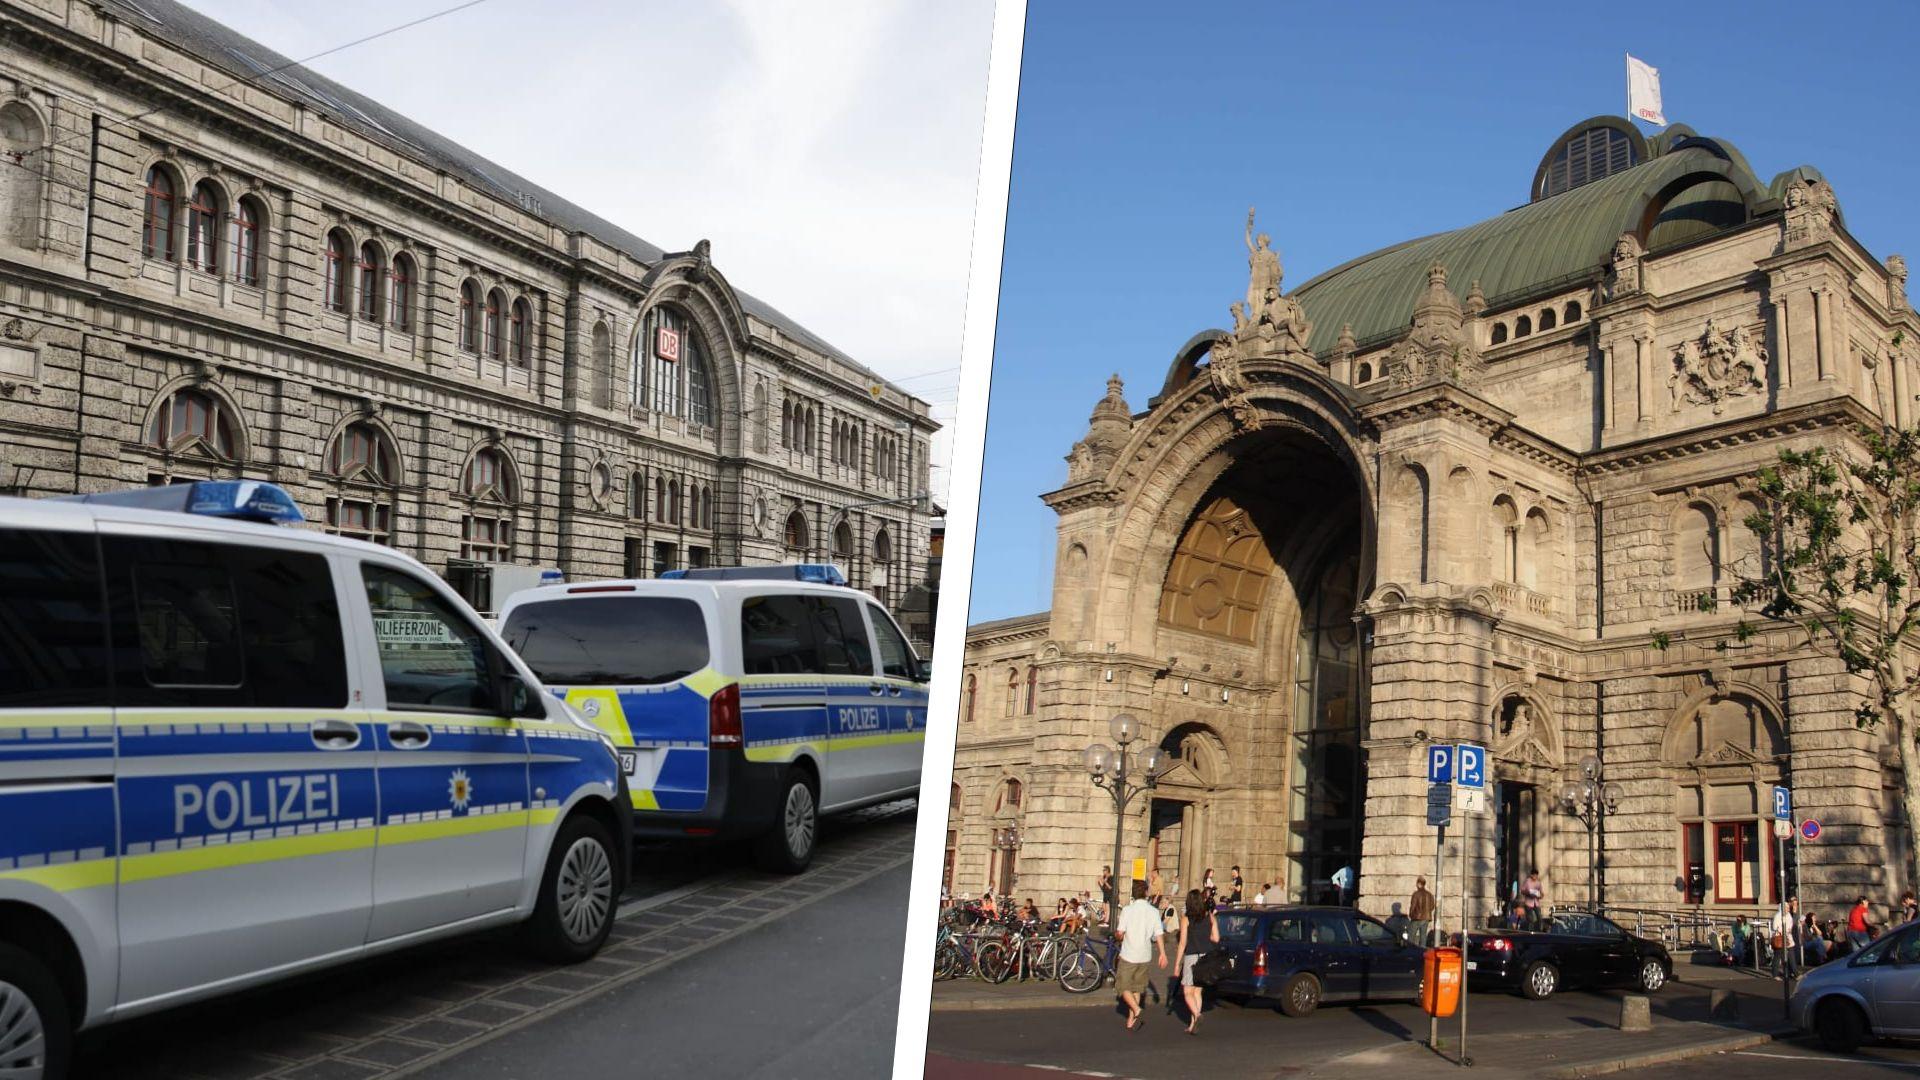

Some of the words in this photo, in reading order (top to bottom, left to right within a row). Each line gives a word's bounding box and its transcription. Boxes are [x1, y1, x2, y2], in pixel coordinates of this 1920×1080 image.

[662, 332, 676, 355] DB
[839, 707, 880, 732] POLIZEI
[1433, 750, 1448, 779] P
[1461, 750, 1477, 781] P
[174, 774, 339, 834] POLIZEI
[1776, 791, 1785, 815] P
